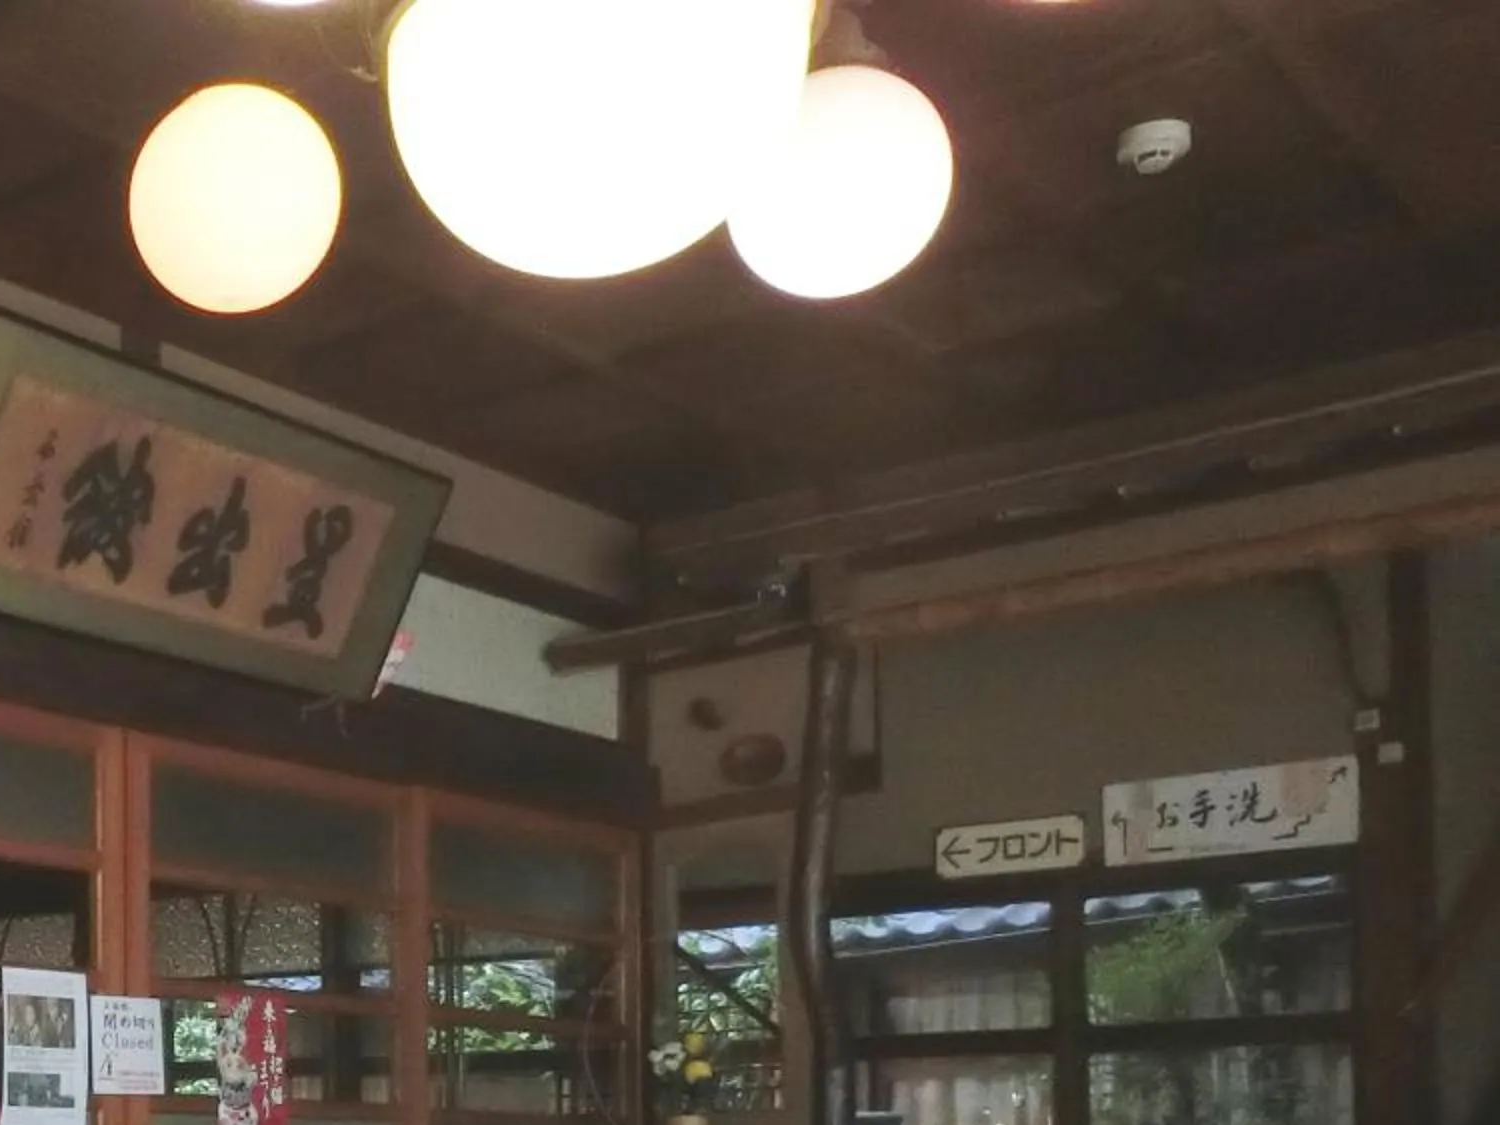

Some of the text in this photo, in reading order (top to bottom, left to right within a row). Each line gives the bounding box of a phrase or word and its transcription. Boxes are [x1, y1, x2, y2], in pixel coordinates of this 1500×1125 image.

[977, 829, 1080, 864] フロント
[101, 1031, 155, 1051] Closed
